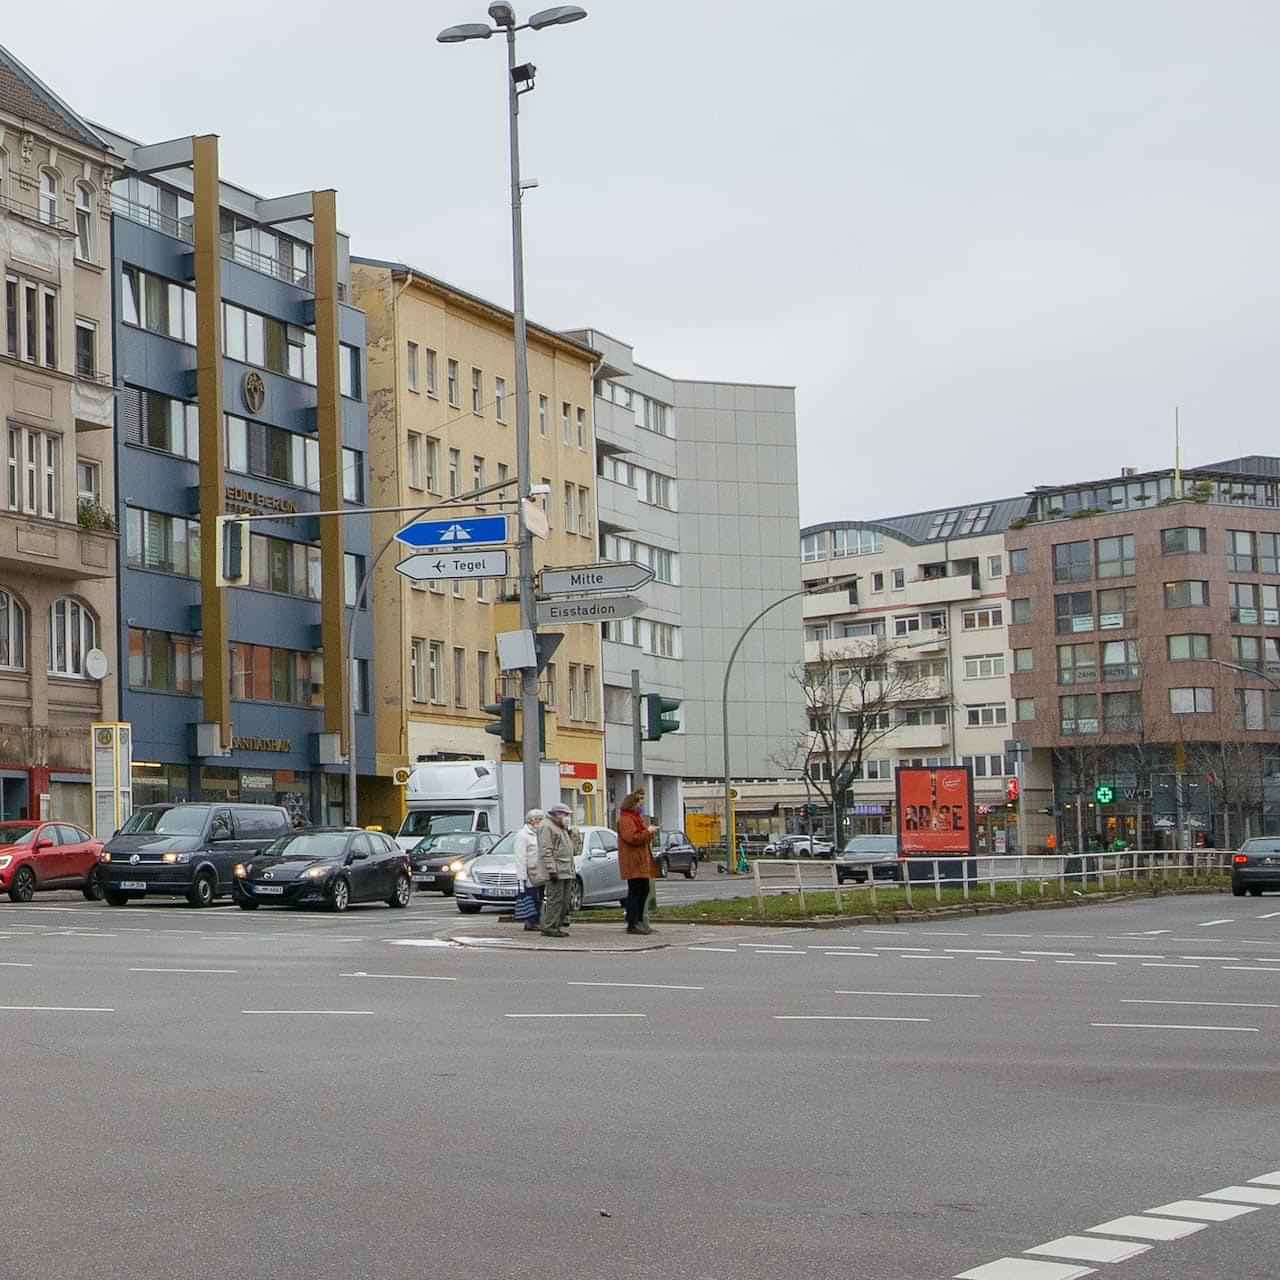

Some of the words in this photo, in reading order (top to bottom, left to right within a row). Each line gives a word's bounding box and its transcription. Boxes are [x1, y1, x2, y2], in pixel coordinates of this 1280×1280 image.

[257, 494, 298, 513] BERLIN
[452, 560, 486, 571] Tegel
[570, 575, 604, 586] Mitte
[550, 604, 616, 618] Eisstadion
